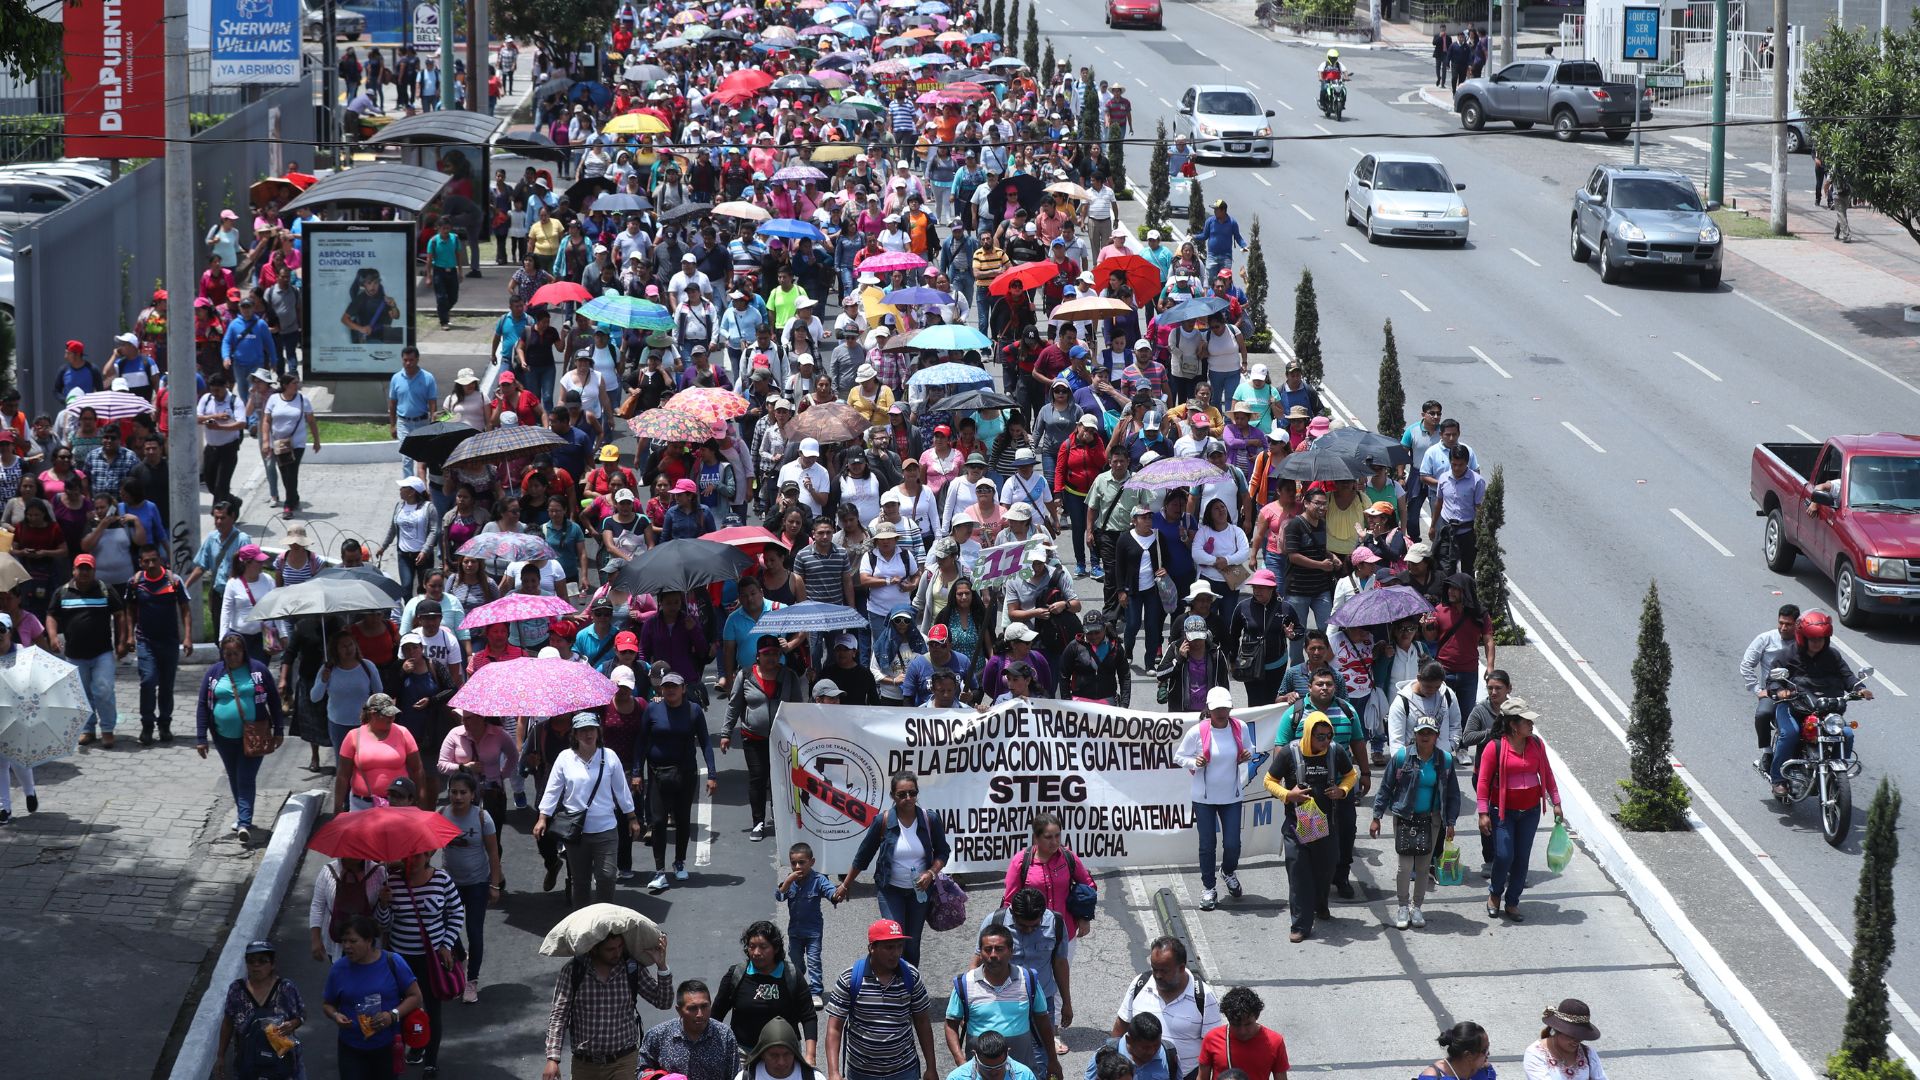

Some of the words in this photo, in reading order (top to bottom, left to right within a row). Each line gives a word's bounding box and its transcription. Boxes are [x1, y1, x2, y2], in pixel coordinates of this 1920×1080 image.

[218, 19, 291, 36] SHERWIN
[1635, 24, 1648, 33] SER
[1647, 12, 1655, 21] ES
[217, 37, 291, 53] WILLIAMS
[126, 31, 134, 93] HAMBURGUESAS
[217, 64, 235, 77] ¡YA
[237, 63, 294, 76] ABRIMOS!
[319, 249, 365, 258] ABRÓCHESE
[905, 711, 999, 747] SINDICATO
[1004, 708, 1029, 738] DE
[1031, 709, 1184, 745] TRABAJADOR@S
[889, 750, 914, 776] DE
[918, 751, 942, 776] LA
[945, 741, 1051, 773] EDUCACION
[1056, 742, 1078, 772] DE
[1081, 742, 1183, 771] GUATEMAL
[806, 777, 867, 823] STEG
[989, 775, 1088, 804] STEG
[1089, 806, 1108, 830] DE
[955, 834, 1028, 862] PRESENTE
[1076, 833, 1128, 858] LUCHA.
